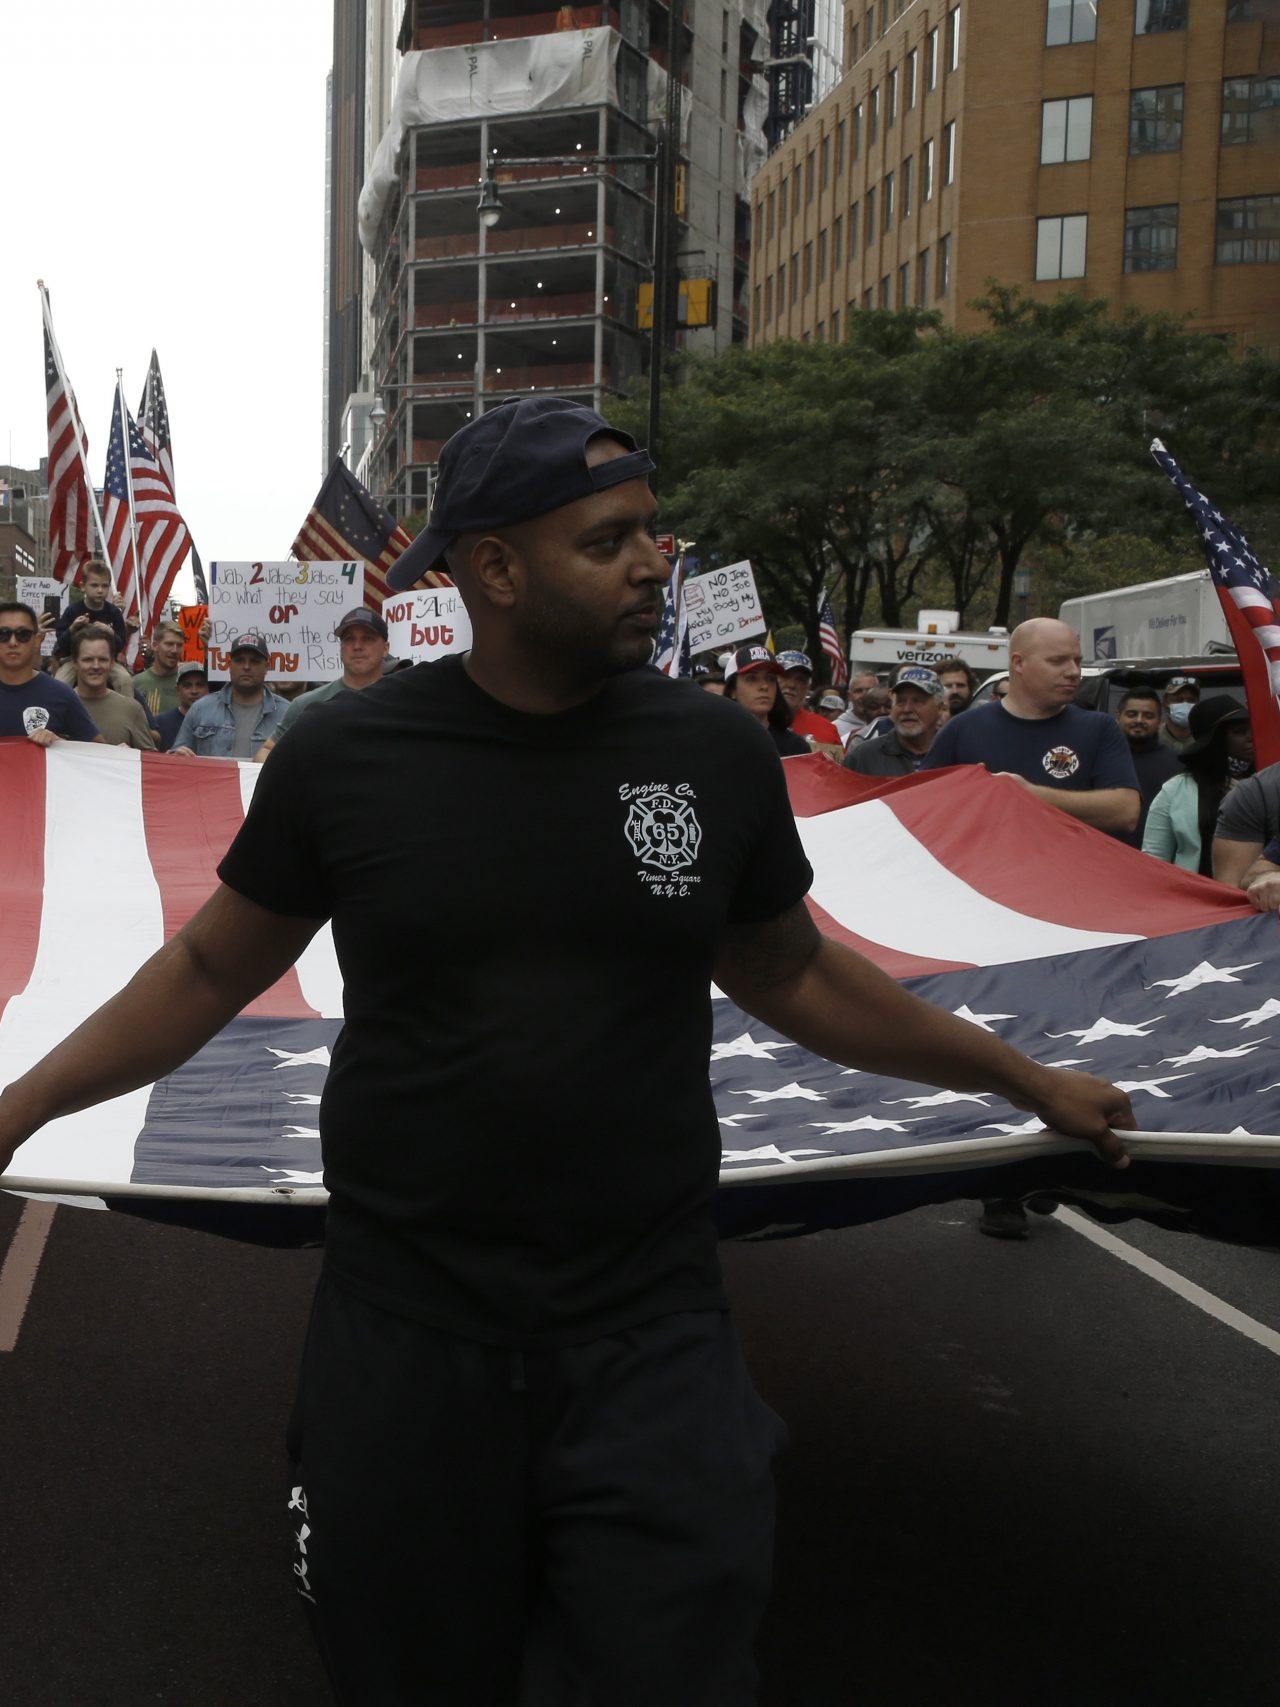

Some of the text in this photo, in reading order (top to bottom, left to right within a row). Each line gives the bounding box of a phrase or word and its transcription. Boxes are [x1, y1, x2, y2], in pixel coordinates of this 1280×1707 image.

[249, 562, 265, 585] 2
[295, 561, 309, 585] 3
[341, 563, 357, 585] 4
[708, 573, 728, 592] NO
[212, 586, 344, 605] Do what they say
[713, 588, 729, 600] NO
[269, 605, 299, 624] or
[385, 602, 414, 623] NOT
[214, 621, 238, 644] Be
[299, 626, 321, 644] the
[410, 623, 454, 647] but
[717, 623, 735, 636] GO
[208, 647, 299, 672] Tyny
[307, 645, 344, 670] Risi
[897, 648, 954, 662] verizon
[619, 782, 697, 800] Engine Co.
[651, 799, 674, 809] F.D.
[653, 823, 680, 840] 65
[659, 854, 680, 865] N.Y.
[637, 870, 701, 885] Times Square
[650, 884, 691, 898] N.Y.C.
